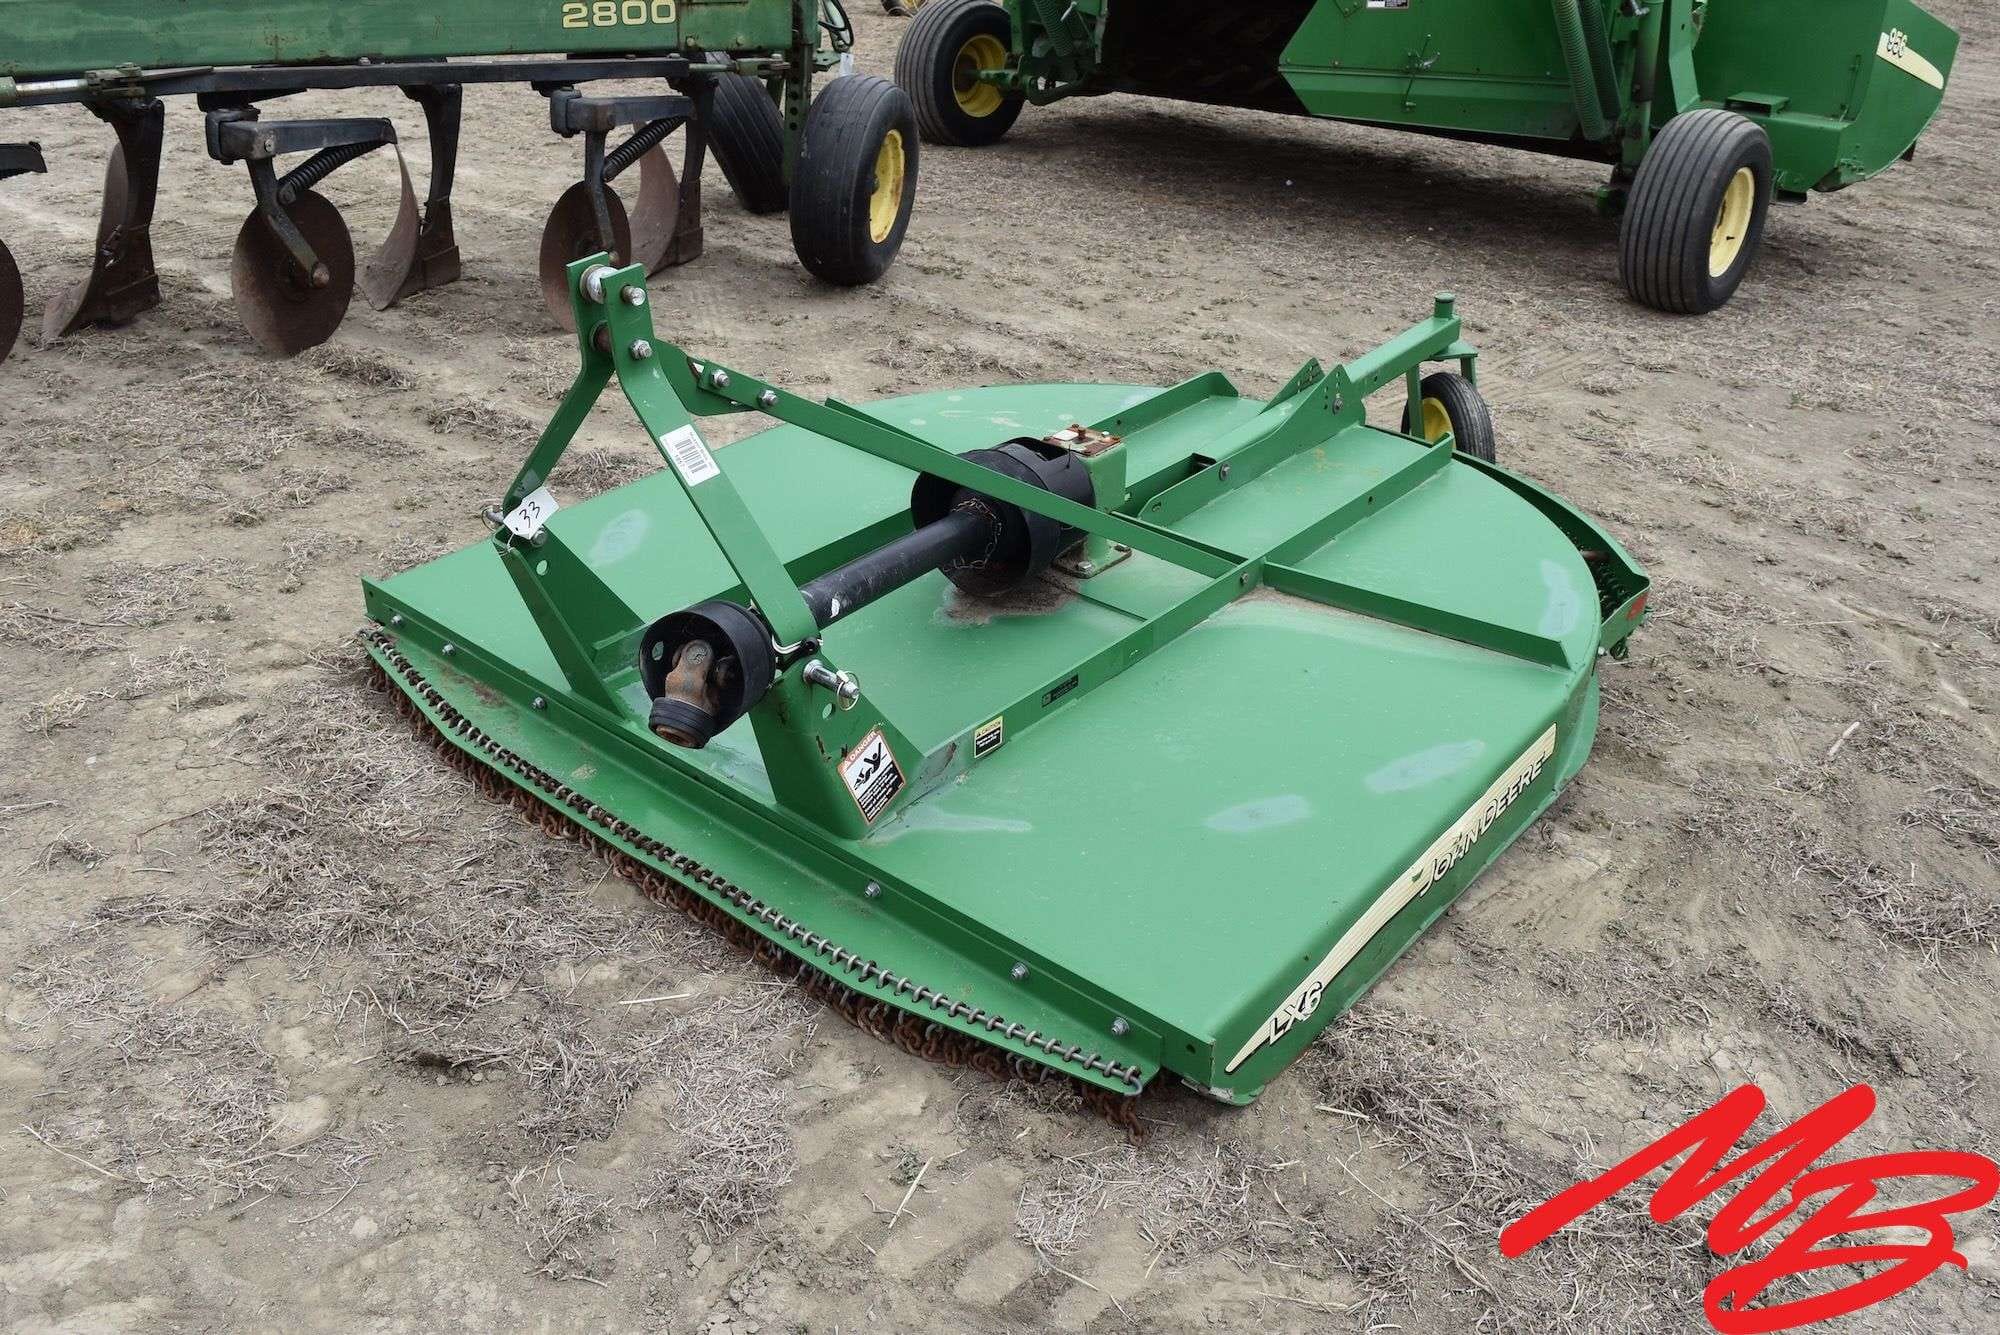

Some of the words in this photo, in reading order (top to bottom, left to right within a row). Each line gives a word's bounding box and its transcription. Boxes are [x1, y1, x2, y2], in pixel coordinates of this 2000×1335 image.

[562, 0, 676, 28] 2800
[849, 731, 878, 761] DANGER
[1420, 820, 1481, 898] JOHN
[1481, 757, 1543, 836] DEERE
[1269, 980, 1323, 1046] LX6
